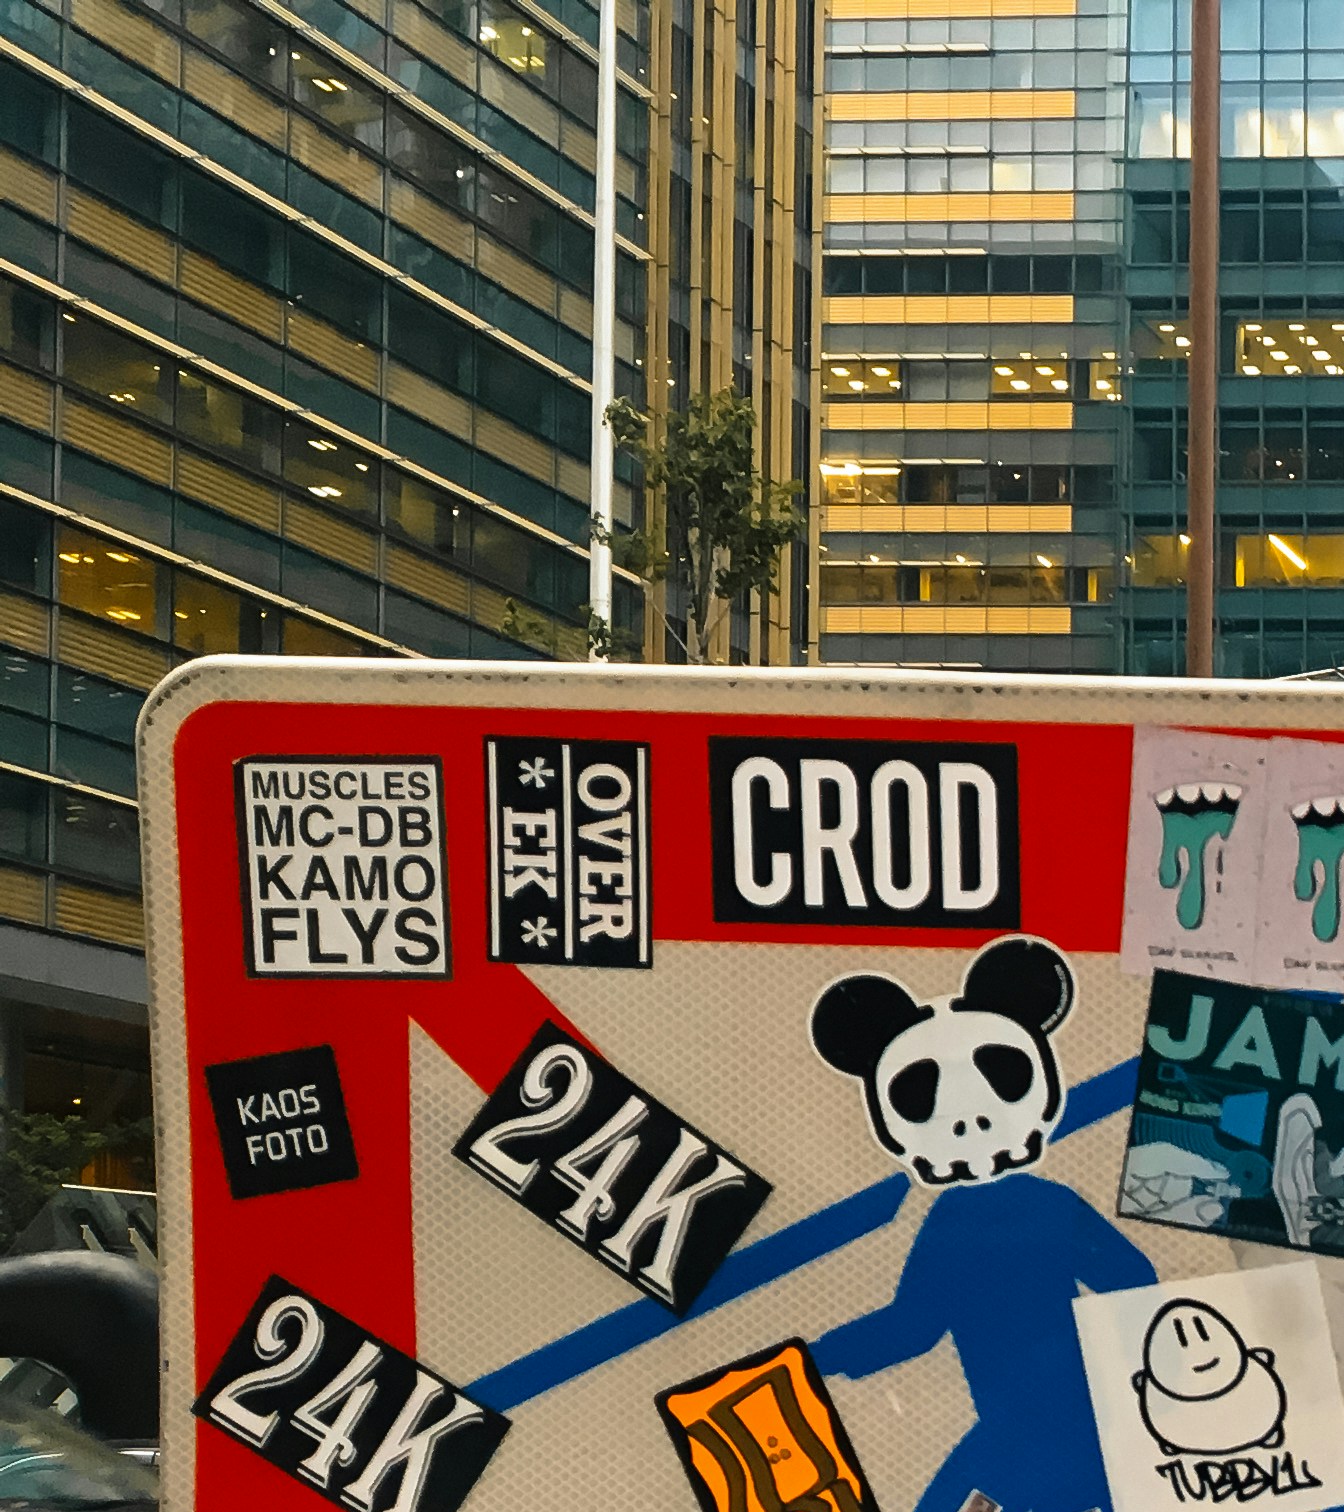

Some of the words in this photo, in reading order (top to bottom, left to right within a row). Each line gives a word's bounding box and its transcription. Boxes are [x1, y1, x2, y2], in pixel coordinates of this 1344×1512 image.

[251, 770, 432, 801] MUSCLES
[253, 804, 434, 848] MC-DB
[731, 756, 1000, 911] CROD
[257, 853, 436, 902] KAMO
[577, 762, 634, 944] OVER
[261, 906, 440, 966] FLYS
[236, 1084, 321, 1125] KAOS
[245, 1125, 329, 1166] FOTO
[469, 1042, 747, 1305] 24K
